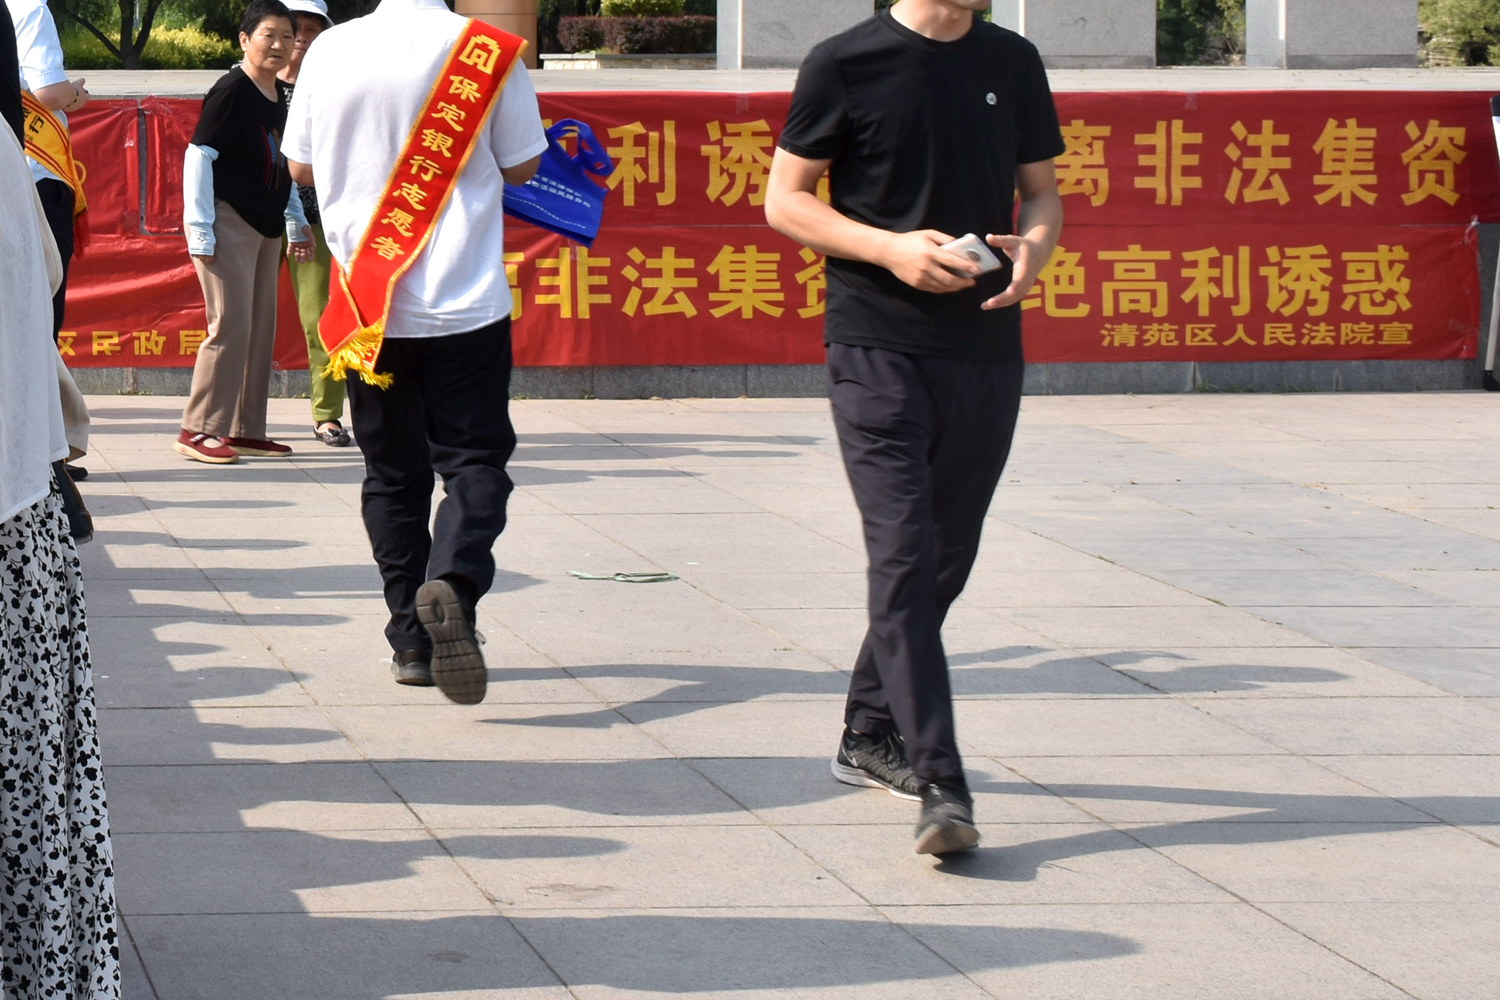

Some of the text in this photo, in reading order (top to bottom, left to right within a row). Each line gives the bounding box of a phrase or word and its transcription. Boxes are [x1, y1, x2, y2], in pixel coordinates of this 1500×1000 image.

[370, 74, 481, 261] 保定银行志愿者
[1014, 118, 1467, 206] 离非法集资
[1100, 321, 1414, 348] 清苑区人民法院宣
